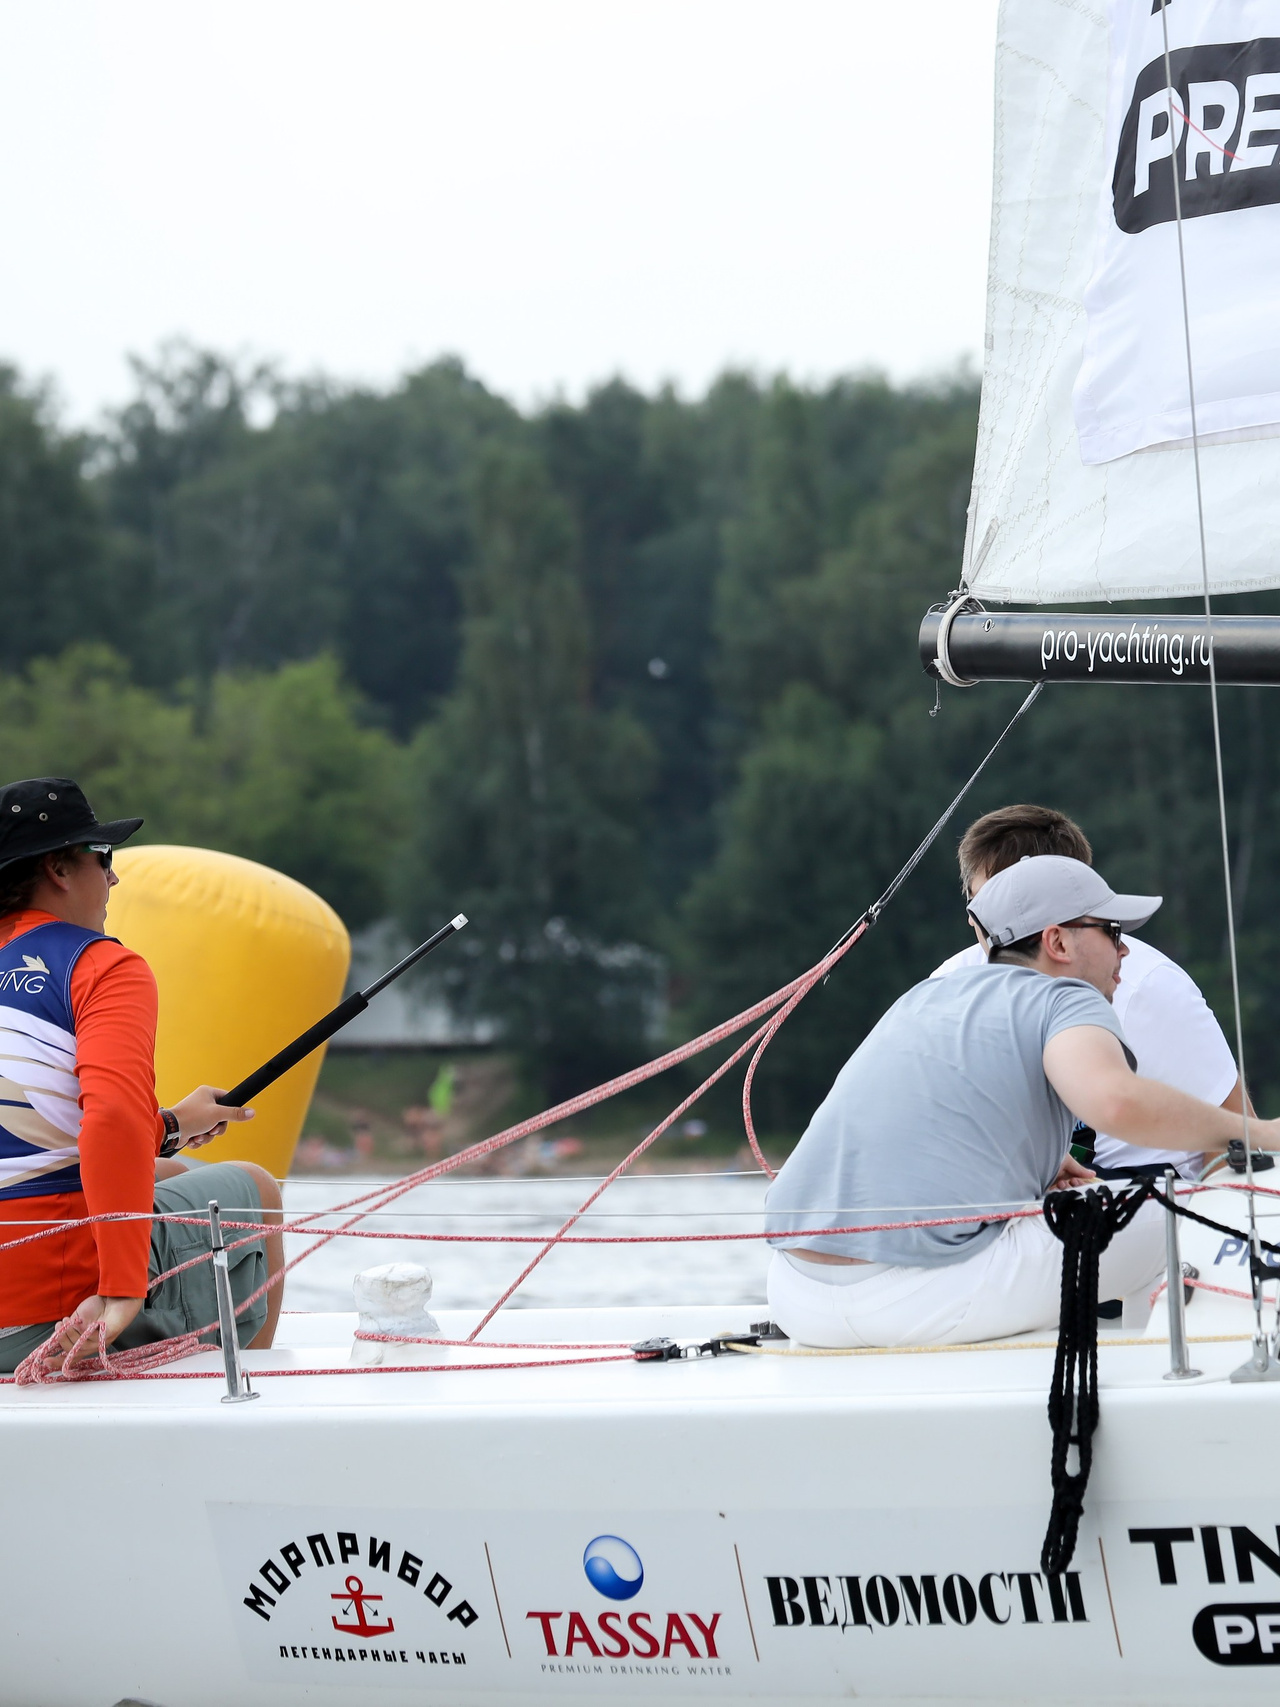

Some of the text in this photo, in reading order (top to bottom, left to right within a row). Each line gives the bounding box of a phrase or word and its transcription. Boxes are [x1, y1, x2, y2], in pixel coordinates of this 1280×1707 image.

[1041, 622, 1214, 675] pro-yachting.ru
[0, 971, 46, 994] ING
[243, 1531, 479, 1629] МОРПРИБОР
[763, 1571, 1091, 1634] ВЕДОМОСТИ
[279, 1645, 466, 1665] ЛЕГЕНДАРНЫЕ ЧАСЫ
[525, 1611, 722, 1659] TASSAY
[540, 1664, 732, 1676] PREMIUM DRINKING WATER
